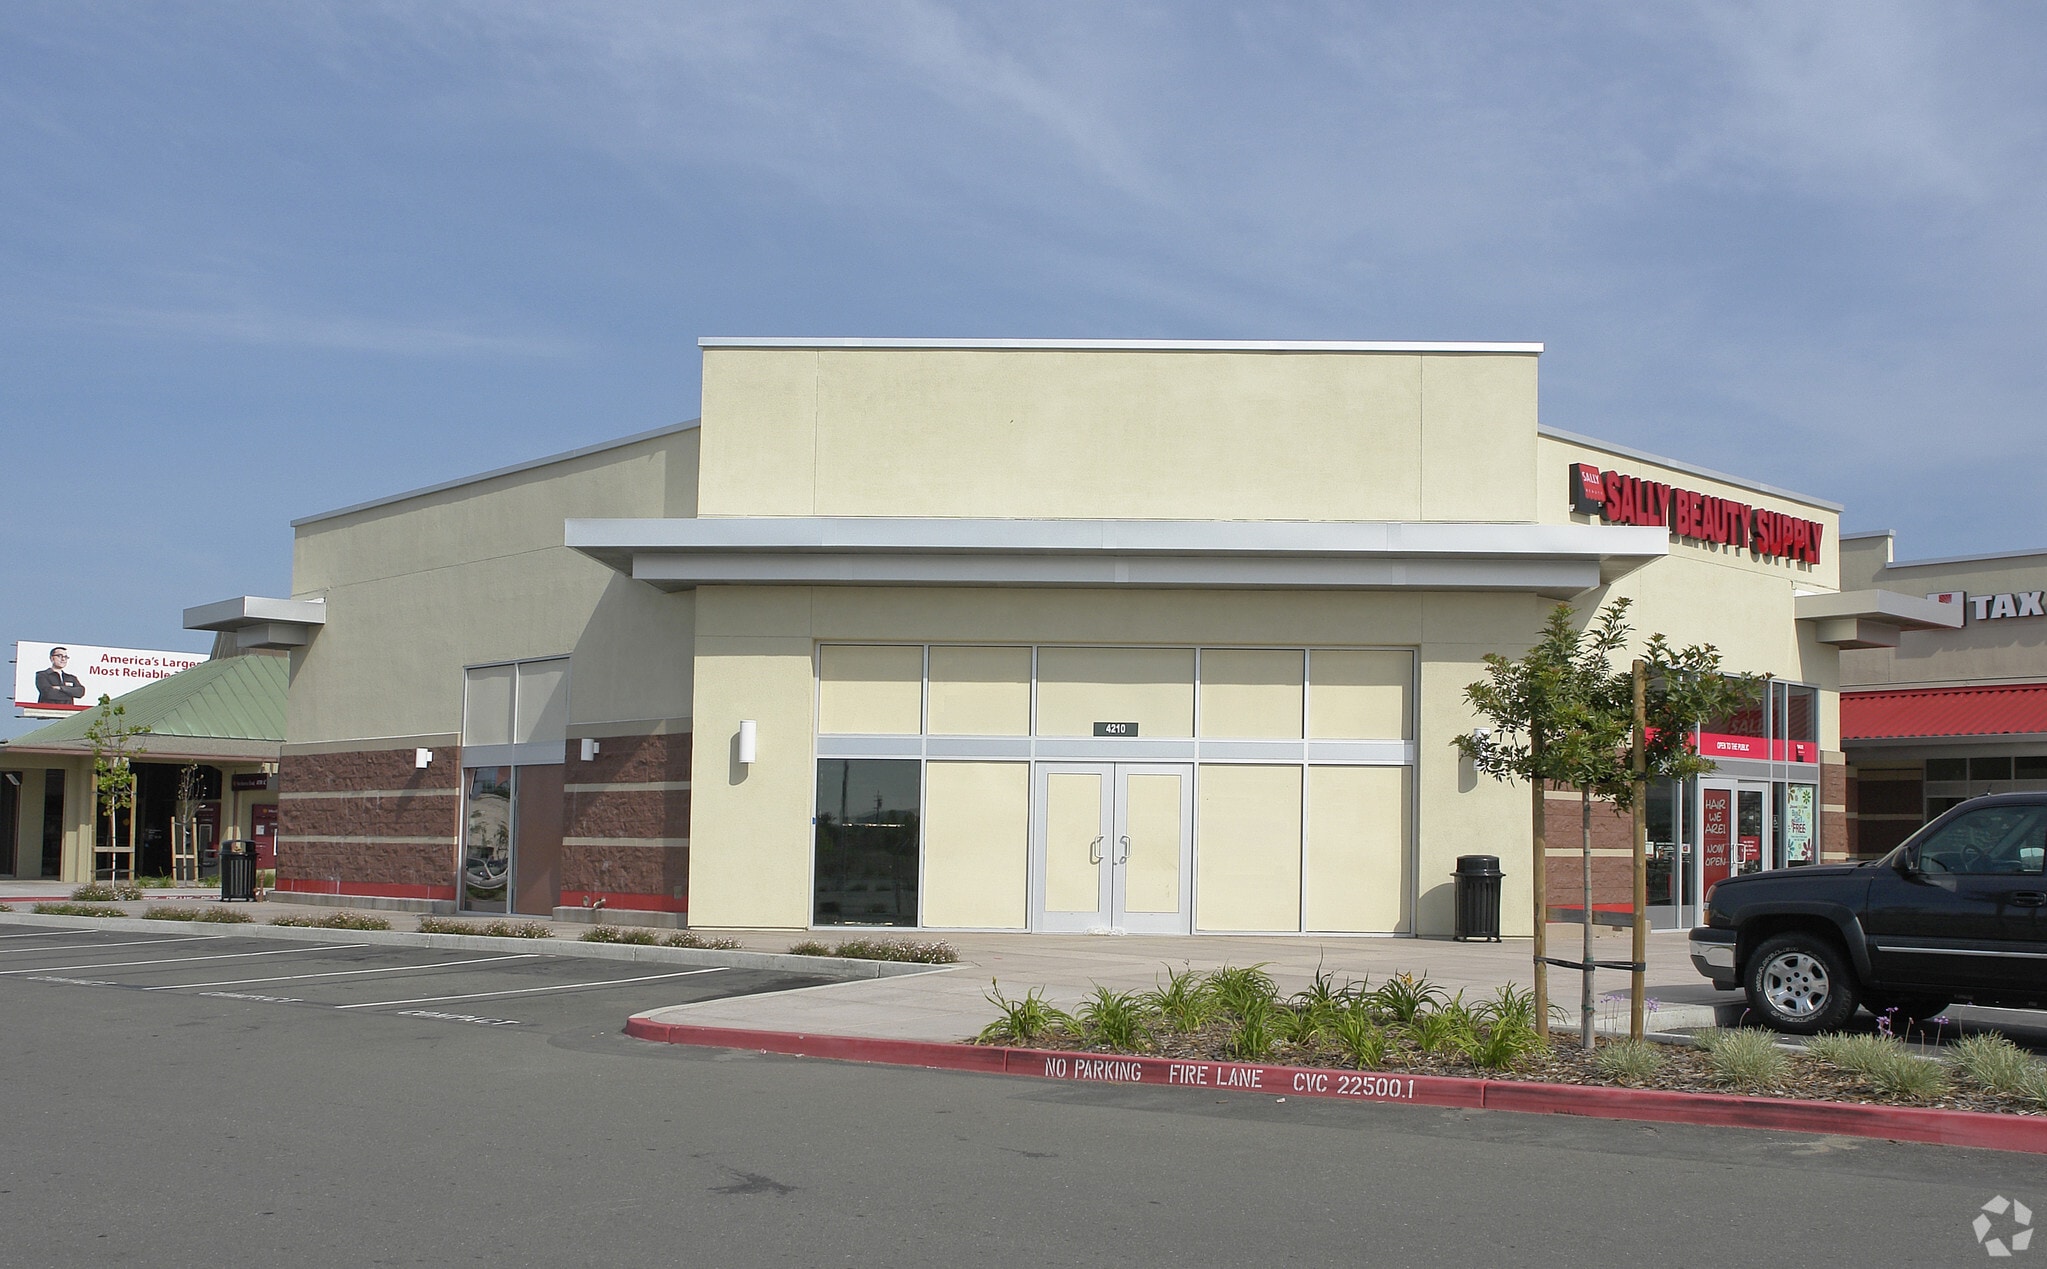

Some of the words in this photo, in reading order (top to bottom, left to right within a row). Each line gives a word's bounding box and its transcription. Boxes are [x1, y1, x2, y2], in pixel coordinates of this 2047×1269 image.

[1581, 471, 1600, 485] SALLY
[1605, 470, 1671, 526] SALLY
[1674, 488, 1752, 548] BEAUTY
[1756, 508, 1823, 565] SUPPLY
[1970, 591, 2044, 620] TAX
[100, 653, 159, 667] America's
[89, 665, 119, 677] Most
[122, 667, 171, 679] Reliable
[1105, 723, 1126, 733] 4210
[1705, 799, 1726, 810] HAIR
[1708, 811, 1722, 822] WE
[1705, 823, 1726, 834] ARE!
[1706, 844, 1725, 854] NOW
[1705, 857, 1726, 867] OPEN
[1045, 1057, 1067, 1078] NO
[1074, 1059, 1142, 1082] PARKING
[1168, 1064, 1209, 1085] FIRE
[1216, 1066, 1263, 1088] LANE
[1293, 1072, 1328, 1093] CVC
[1337, 1075, 1415, 1099] 22500.1
